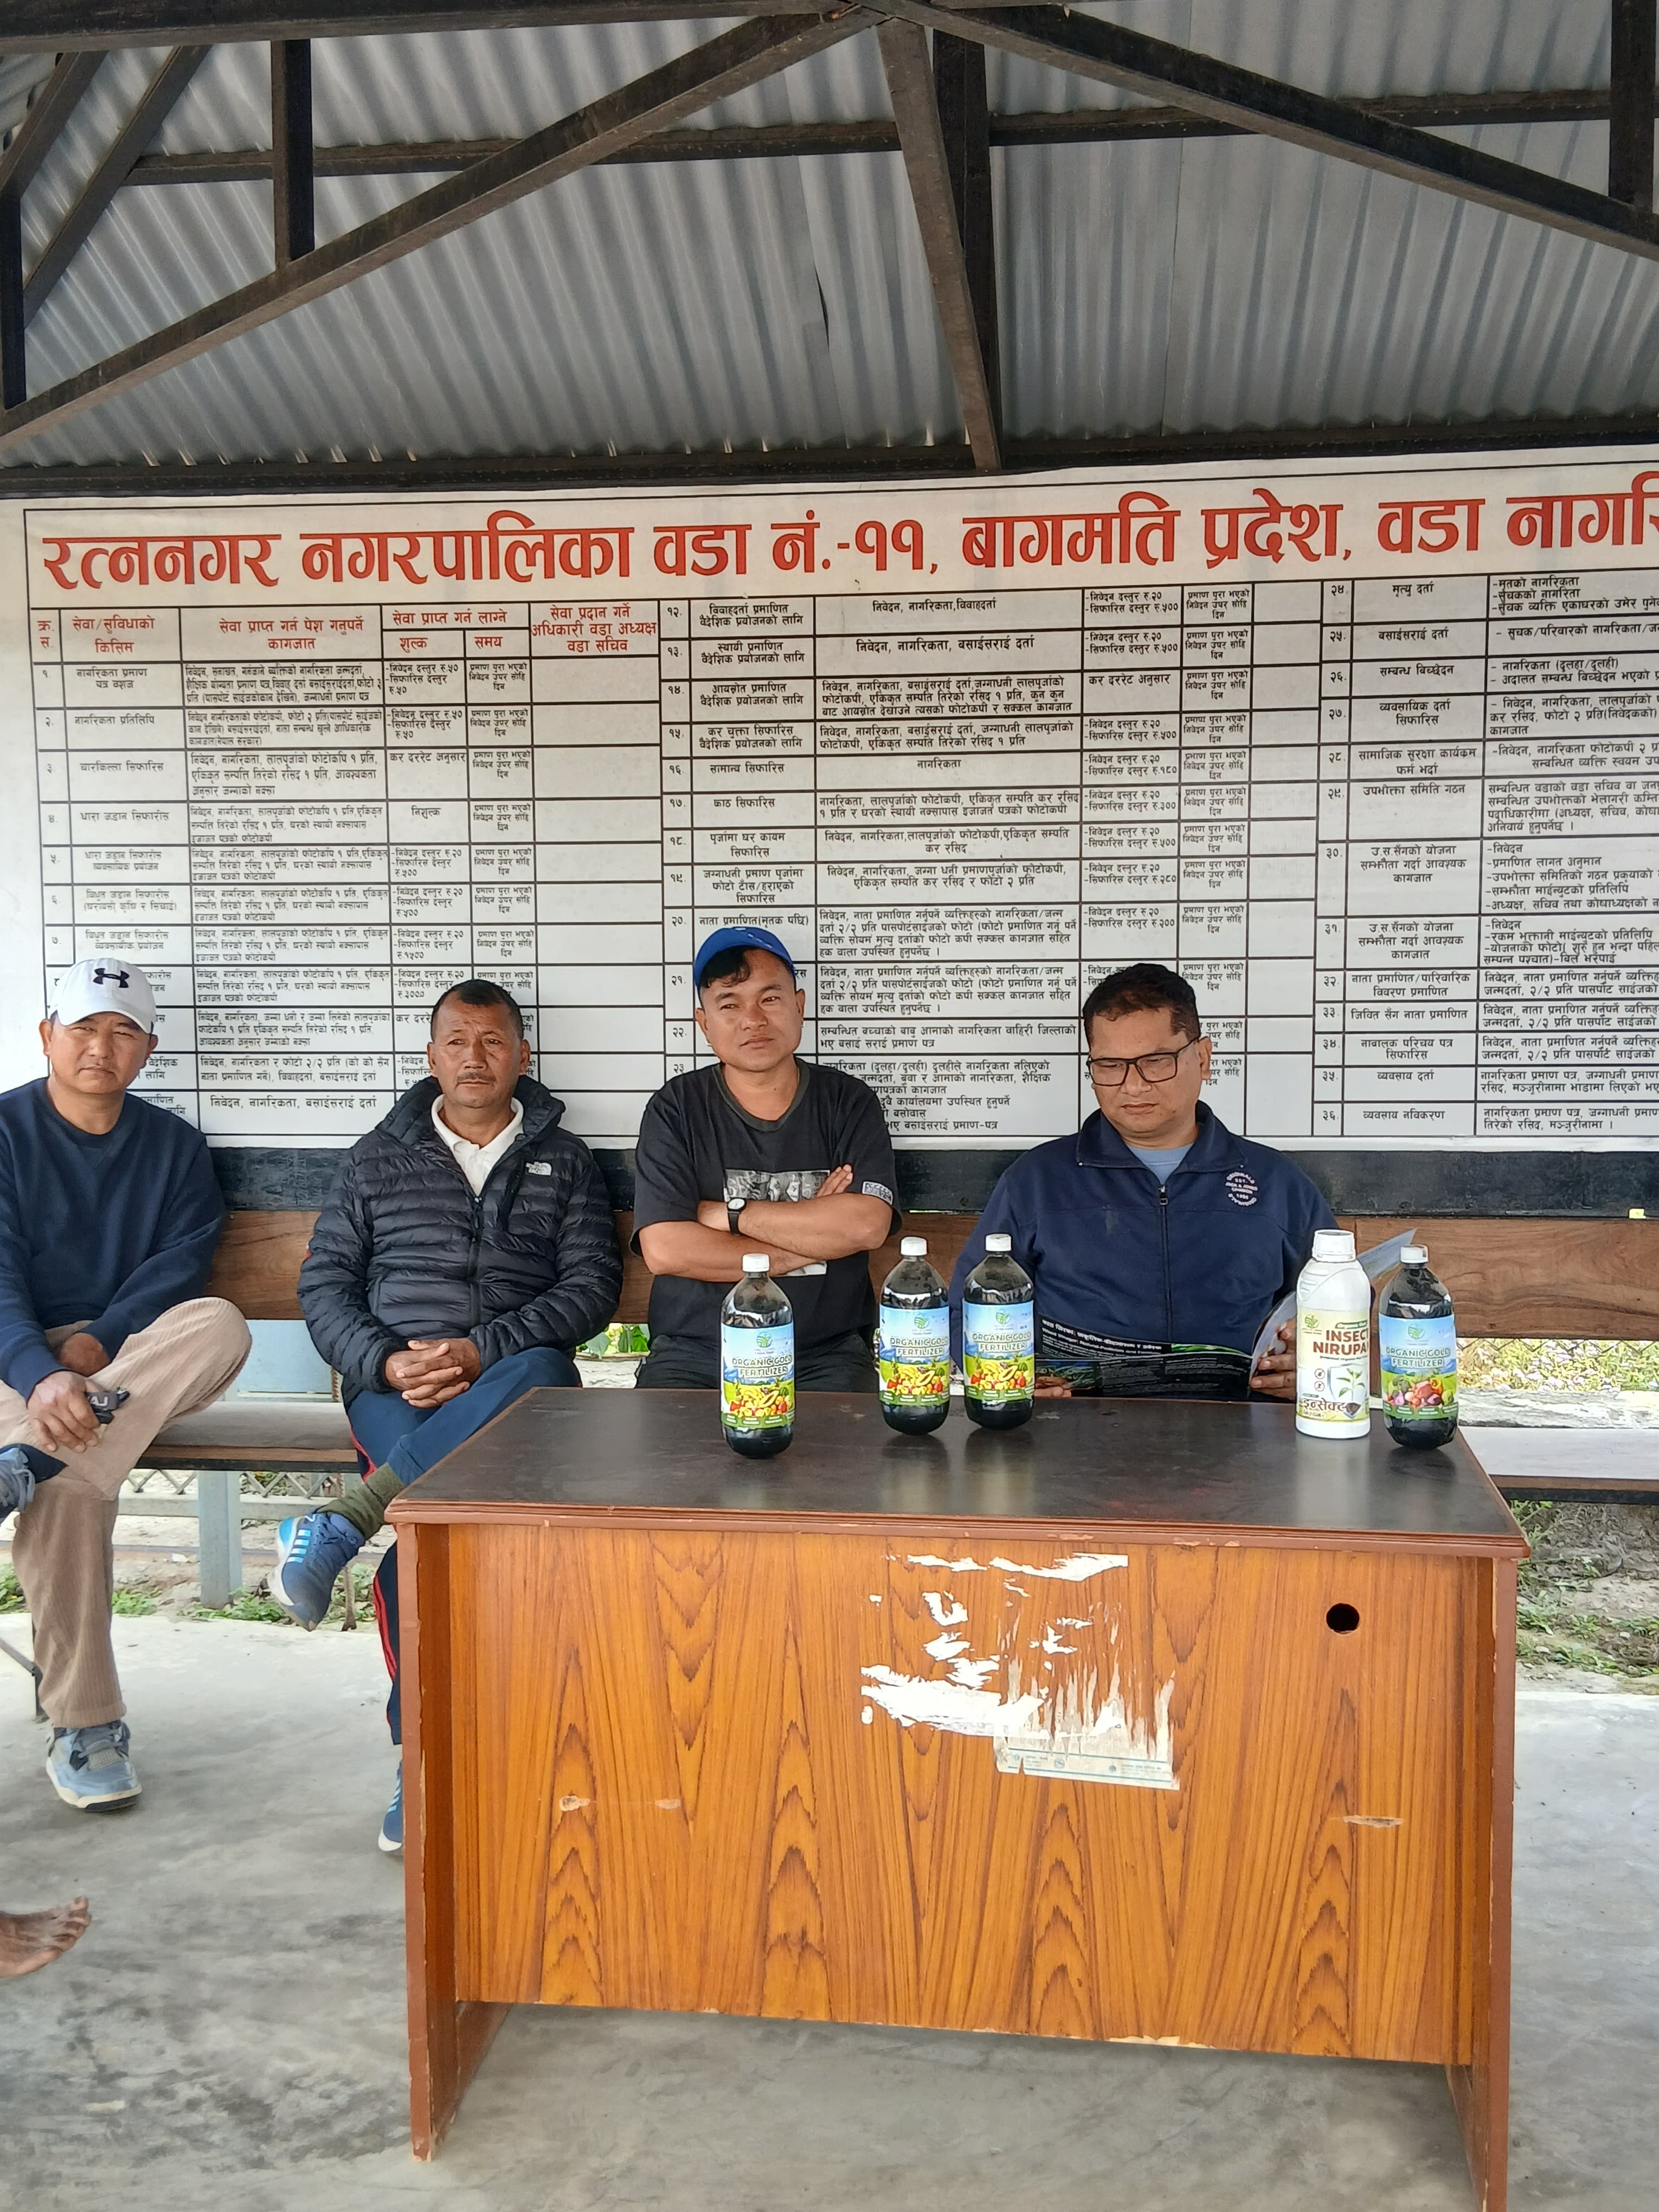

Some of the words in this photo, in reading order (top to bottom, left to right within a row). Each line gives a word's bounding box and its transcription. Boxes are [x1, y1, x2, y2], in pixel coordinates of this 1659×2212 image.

[42, 533, 282, 590] रत्ननगर
[299, 510, 635, 585] नगरपालिका
[653, 524, 753, 576] वडा
[962, 491, 1181, 568] बागमति
[1200, 487, 1352, 570] प्रदेश,
[1377, 498, 1486, 554] वडा
[1416, 581, 1435, 595] दर्ता
[550, 604, 573, 621] सेवा
[578, 607, 607, 621] प्रदान
[613, 602, 631, 618] गर्ने
[753, 601, 789, 615] प्रमाणित
[392, 609, 416, 626] सेवा
[421, 612, 447, 626] प्राप्त
[478, 609, 507, 624] लाग्ने
[736, 614, 778, 627] प्रयोजनको
[781, 612, 804, 626] लागि
[218, 618, 242, 634] सेवा
[247, 620, 275, 633] प्राप्त
[304, 616, 324, 633] पेश
[531, 621, 583, 638] अधिकारी
[589, 623, 612, 636] वडा
[618, 622, 657, 635] अध्यक्ष
[1431, 626, 1449, 640] दर्ता
[94, 638, 135, 654] किसिम
[267, 638, 317, 650] कागजात
[399, 637, 428, 653] शुल्क
[474, 636, 504, 650] समय
[567, 640, 590, 653] वडा
[595, 636, 628, 653] सचिव
[736, 693, 779, 706] प्रयोजनको
[782, 692, 805, 705] लागि
[1433, 698, 1451, 712] दर्ता
[1396, 712, 1440, 726] सिफारिस
[707, 727, 723, 738] कर
[754, 723, 794, 736] सिफारिस
[1358, 747, 1403, 761] सामाजिक
[744, 761, 785, 774] सिफारिस
[916, 757, 962, 770] नागरिकता
[1410, 781, 1442, 795] समिति
[1444, 784, 1466, 794] गठन
[736, 795, 776, 808] सिफारिस
[742, 833, 756, 843] घर
[730, 845, 770, 858] सिफारिस
[1425, 844, 1457, 855] योजना
[745, 869, 772, 879] प्रमाण
[712, 879, 735, 891] फोटो
[736, 891, 776, 904] सिफारिस
[1351, 974, 1373, 983] नाता
[1373, 985, 1407, 998] विवरण
[1410, 984, 1449, 998] प्रमाणित
[1350, 1007, 1381, 1020] जिवित
[1404, 1010, 1426, 1020] नाता
[1429, 1007, 1469, 1020] प्रमाणित
[1403, 1036, 1435, 1049] परिचय
[1439, 1039, 1454, 1047] पत्र
[1385, 1047, 1429, 1060] सिफारिस
[1377, 1072, 1413, 1082] व्यवसाय
[1417, 1069, 1435, 1082] दर्ता
[1362, 1111, 1399, 1120] व्यवसाय
[1313, 1341, 1368, 1355] NIRUPA
[1386, 1347, 1425, 1356] ORGANIC
